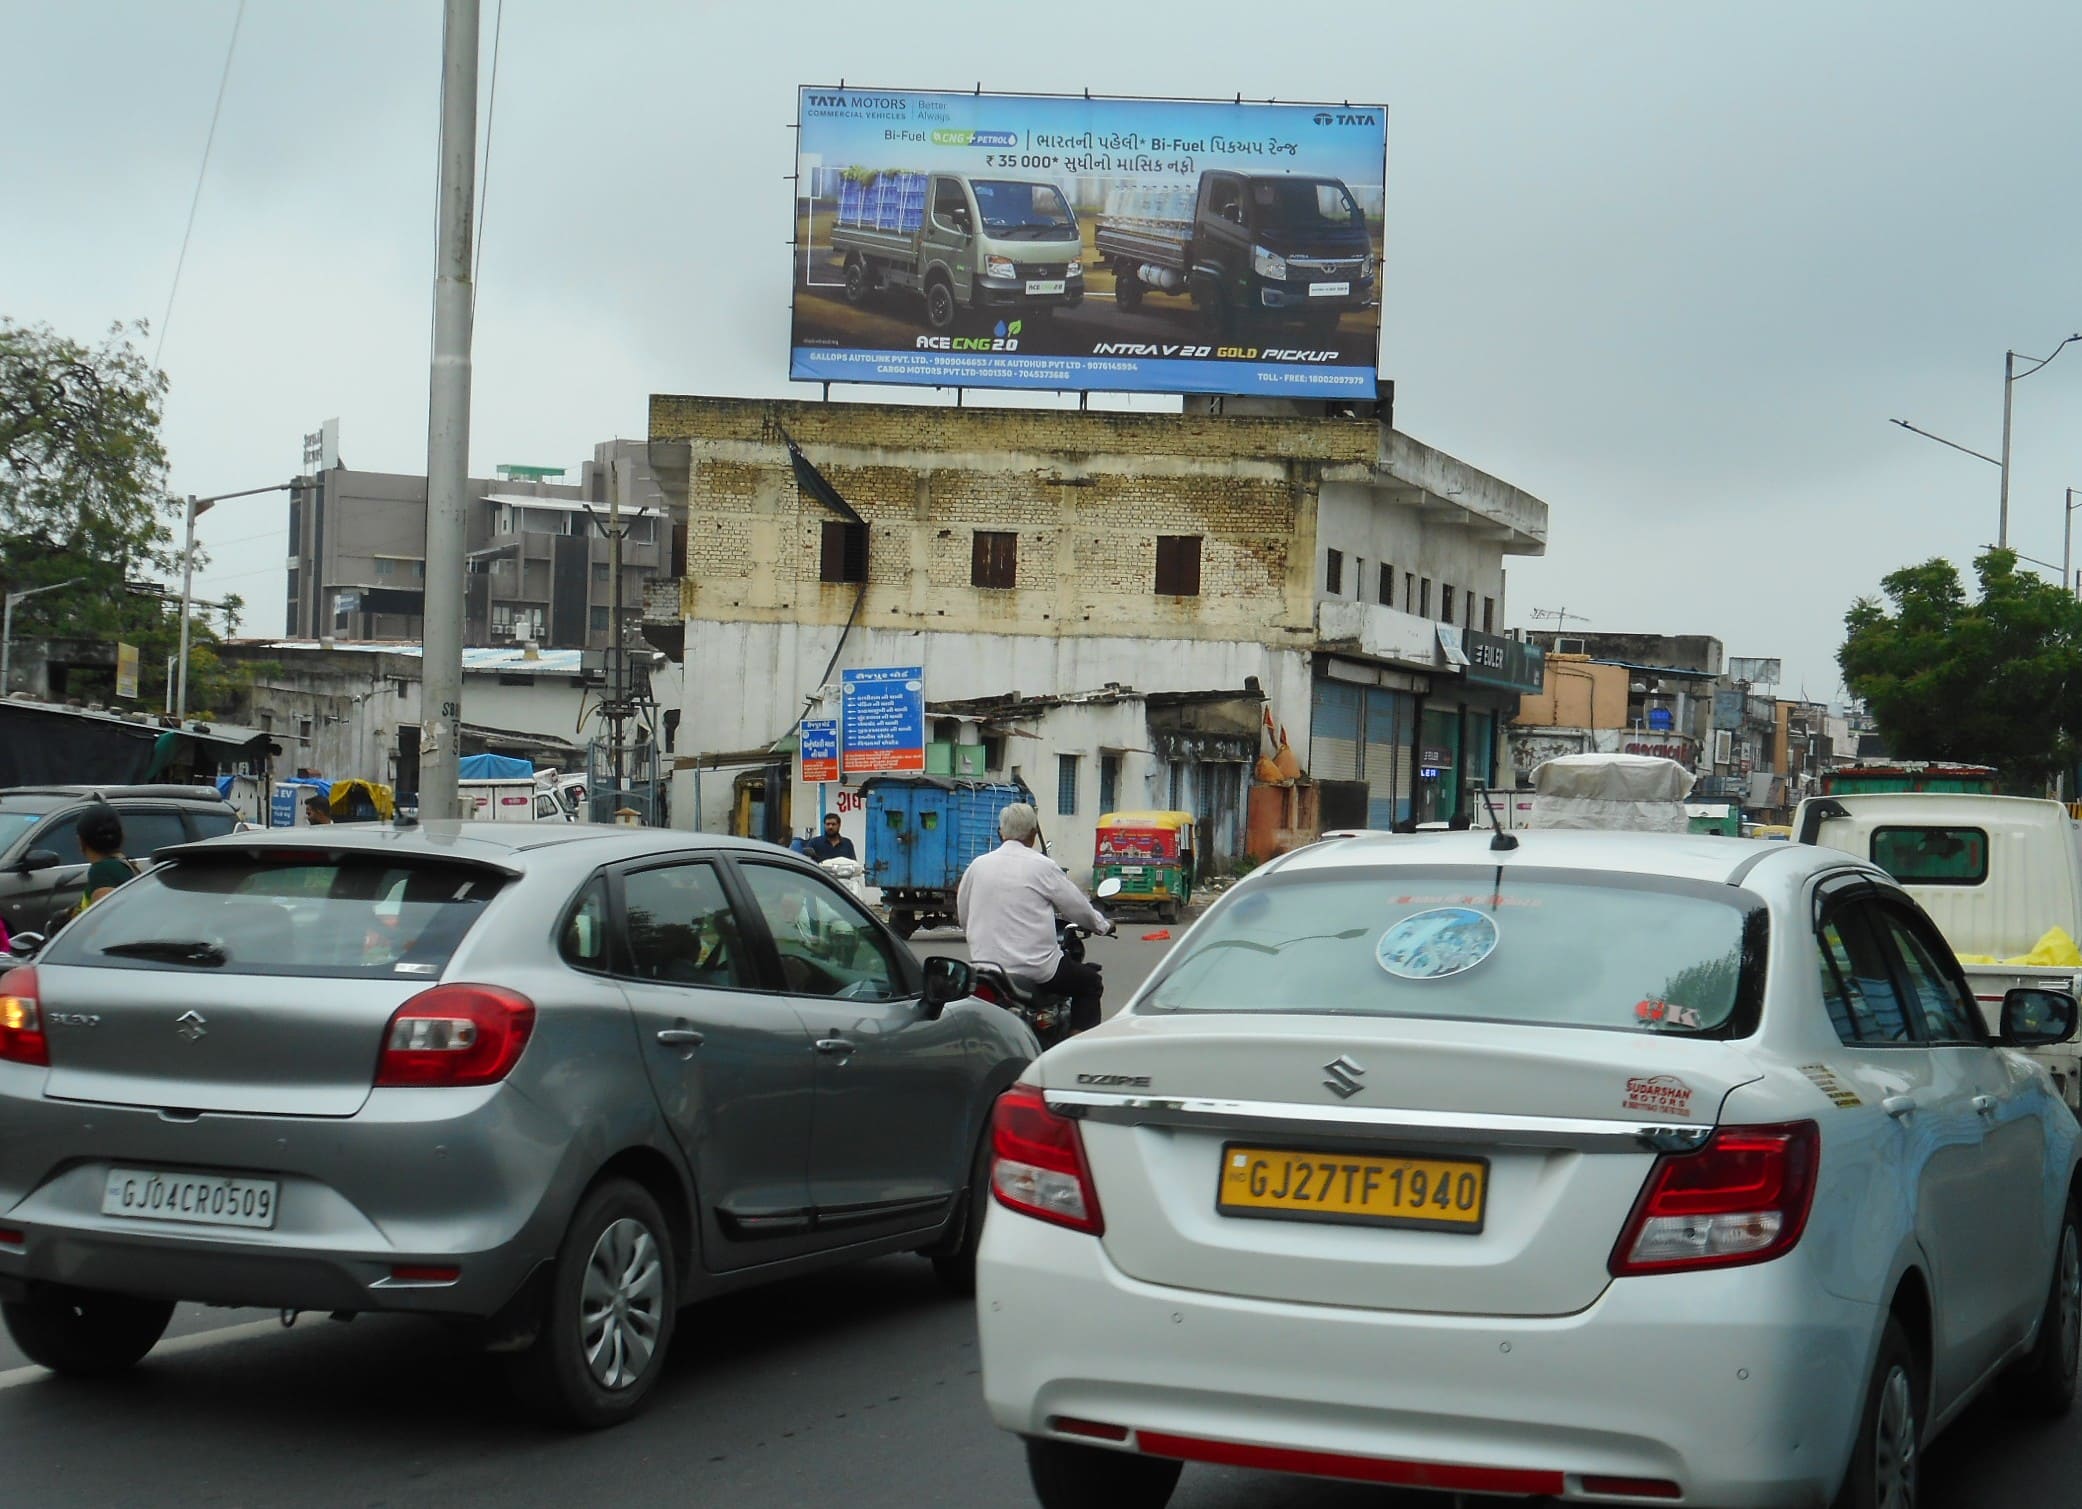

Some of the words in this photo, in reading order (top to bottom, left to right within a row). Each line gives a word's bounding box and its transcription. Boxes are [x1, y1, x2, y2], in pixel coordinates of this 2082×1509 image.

[808, 95, 847, 108] TATA
[851, 96, 906, 110] MOTORS
[918, 100, 946, 110] Better
[808, 110, 863, 119] COMMERCIAL
[866, 112, 906, 120] VEHICLES
[918, 111, 950, 123] Always
[1337, 115, 1375, 126] TATA
[884, 130, 926, 142] Bi-Fuel
[942, 132, 966, 144] CNG
[977, 135, 1008, 145] PETROL
[1037, 132, 1093, 149] ભારતની
[1152, 138, 1205, 152] Bi-Fuel
[1210, 136, 1262, 154] પિકઅપ
[1269, 138, 1298, 156] રેન્જ
[1065, 154, 1111, 173] સુધીનો
[1117, 155, 1162, 173] માસિક
[1167, 157, 1195, 176] નફો
[916, 336, 951, 349] ACE
[952, 337, 990, 350] CNG
[1093, 343, 1158, 355] INTRA
[1180, 346, 1211, 357] 20
[1217, 347, 1258, 359] GOLD
[1261, 349, 1339, 361] PICKUP
[809, 352, 848, 361] GALLOPS
[892, 355, 910, 364] PVT.
[911, 356, 928, 364] LTD.
[1007, 360, 1047, 368] AUTOHUB
[1048, 361, 1065, 369] PVT
[877, 365, 905, 374] CARGO
[907, 366, 943, 375] MOTORS
[1257, 373, 1278, 381] TOLL
[1484, 645, 1504, 669] EULER
[1077, 1073, 1152, 1088] DZIRE
[1626, 1077, 1693, 1100] SUDARSHAN
[1630, 1093, 1685, 1107] MOTORS
[1250, 1160, 1477, 1211] GJ27TF1940
[122, 1179, 271, 1218] GJ04CR0509
